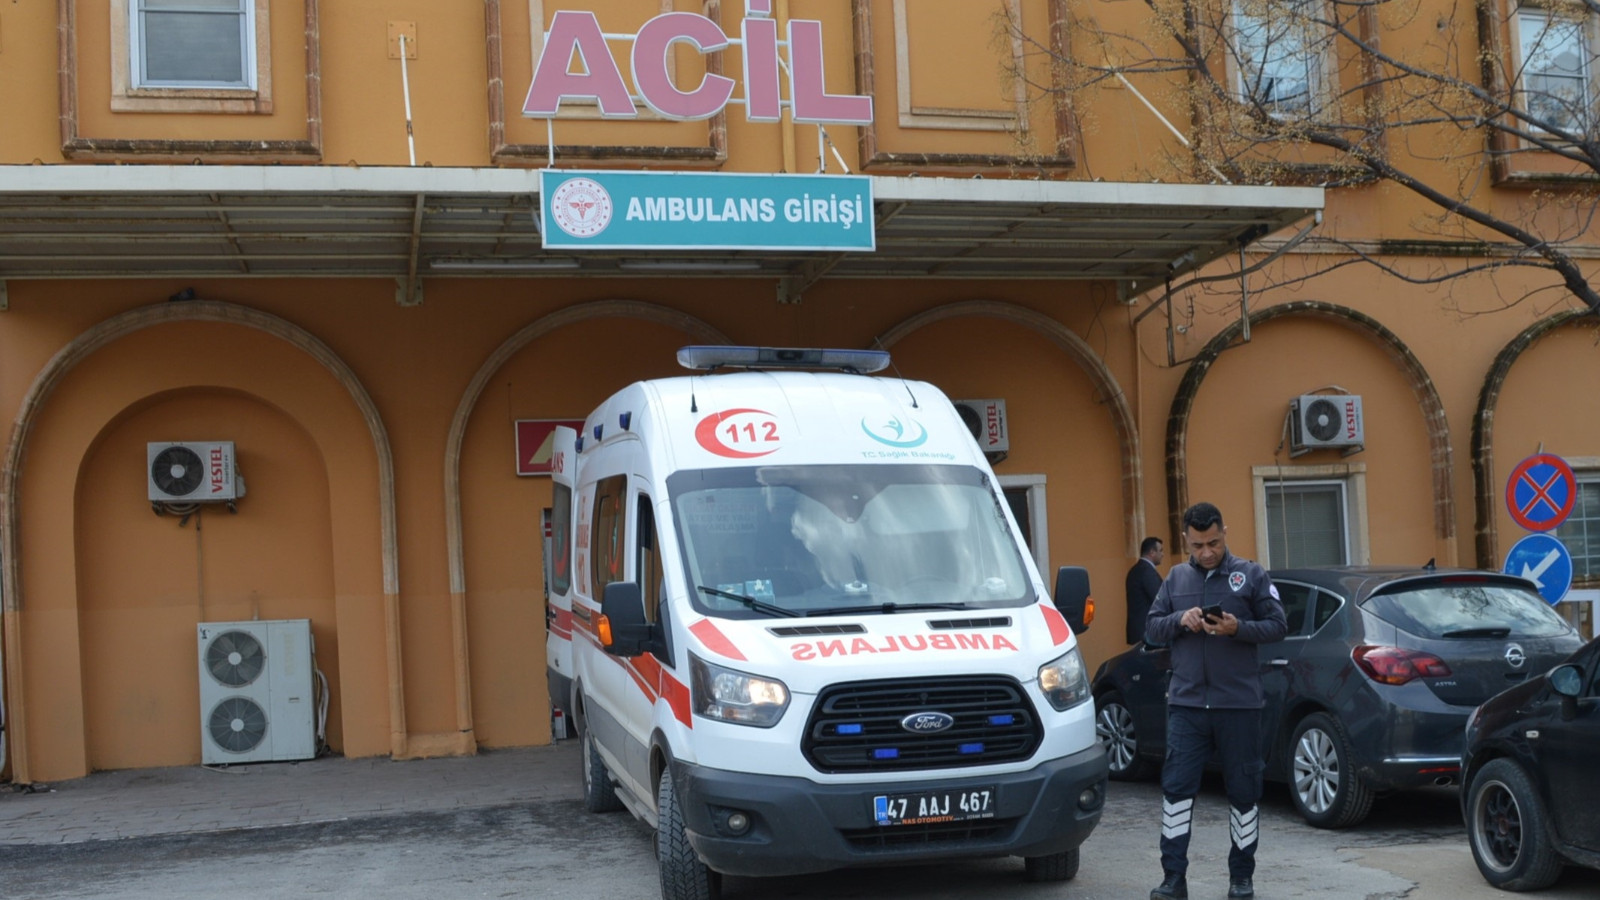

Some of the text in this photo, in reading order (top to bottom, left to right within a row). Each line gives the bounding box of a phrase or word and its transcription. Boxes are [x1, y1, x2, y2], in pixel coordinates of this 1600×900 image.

[522, 0, 873, 125] ACİL
[626, 197, 776, 223] AMBULANS
[784, 194, 863, 229] GİRİŞİ
[726, 421, 780, 443] 112
[987, 402, 998, 445] VESTEL
[1345, 400, 1356, 439] VESTEL
[211, 446, 223, 493] VESTEL
[914, 716, 943, 730] Ford
[887, 791, 990, 819] 47 AAJ 467
